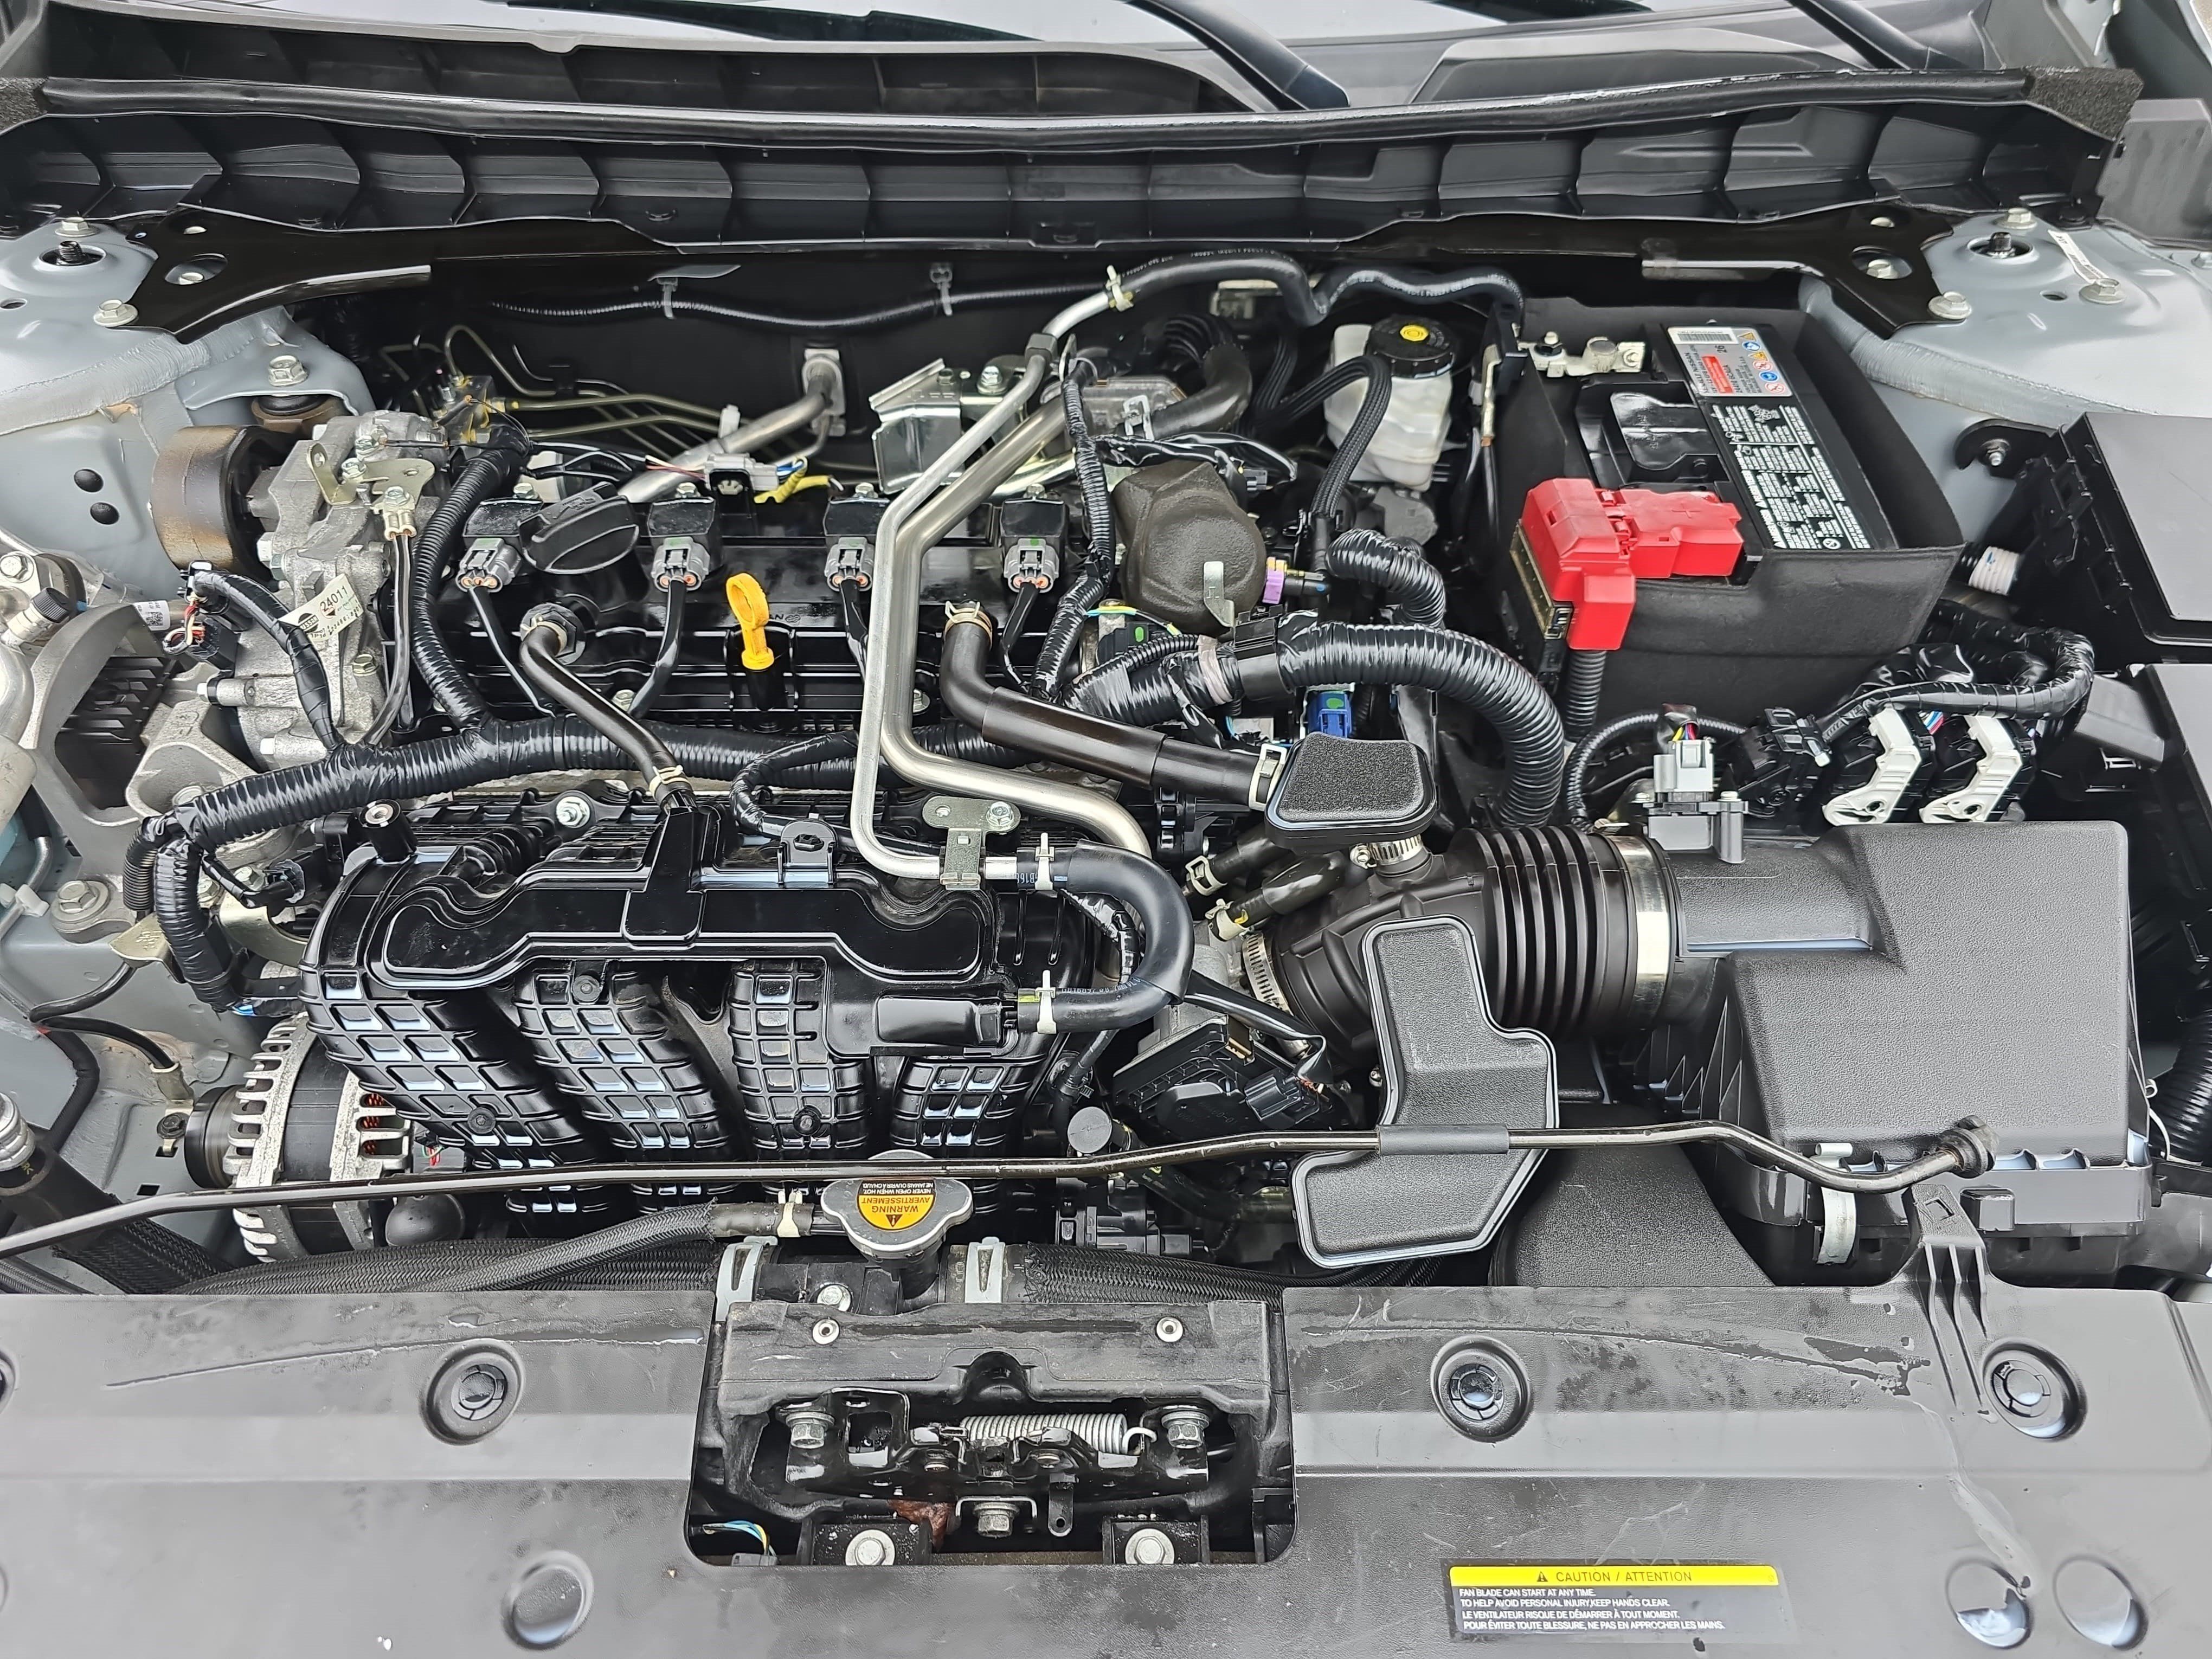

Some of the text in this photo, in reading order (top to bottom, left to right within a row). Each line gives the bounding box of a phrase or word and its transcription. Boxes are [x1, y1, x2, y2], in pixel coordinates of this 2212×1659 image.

[320, 585, 348, 612] 24011
[1555, 1571, 1692, 1582] CAUTION / ATTENTION
[1459, 1589, 1475, 1597] FAN
[1477, 1589, 1502, 1597] BLADE
[1503, 1589, 1521, 1597] CAN
[1522, 1589, 1546, 1597] START
[1547, 1589, 1558, 1597] AT
[1558, 1589, 1574, 1597] ANY
[1461, 1599, 1472, 1607] TO
[1473, 1599, 1494, 1607] HELP
[1495, 1599, 1519, 1607] AVOID
[1520, 1599, 1564, 1607] PERSONAL
[1612, 1599, 1641, 1607] HANDS
[1642, 1598, 1670, 1607] CLEAR.
[1462, 1610, 1473, 1619] LE
[1473, 1610, 1525, 1619] VENTILATEUR
[1525, 1610, 1555, 1619] RISQUE
[1556, 1610, 1570, 1619] DE
[1570, 1608, 1612, 1619] DÉMARRER
[1621, 1610, 1642, 1619] TOUT
[1643, 1610, 1680, 1619] MOMENT.
[1464, 1621, 1488, 1630] POUR
[1487, 1619, 1515, 1630] ÉVITER
[1515, 1621, 1542, 1630] TOUTE
[1543, 1621, 1587, 1630] BLESSURE,
[1587, 1621, 1599, 1629] NE
[1600, 1621, 1617, 1629] PAS
[1617, 1621, 1630, 1629] EN
[1630, 1621, 1681, 1629] APPROCHER
[1680, 1621, 1697, 1629] LES
